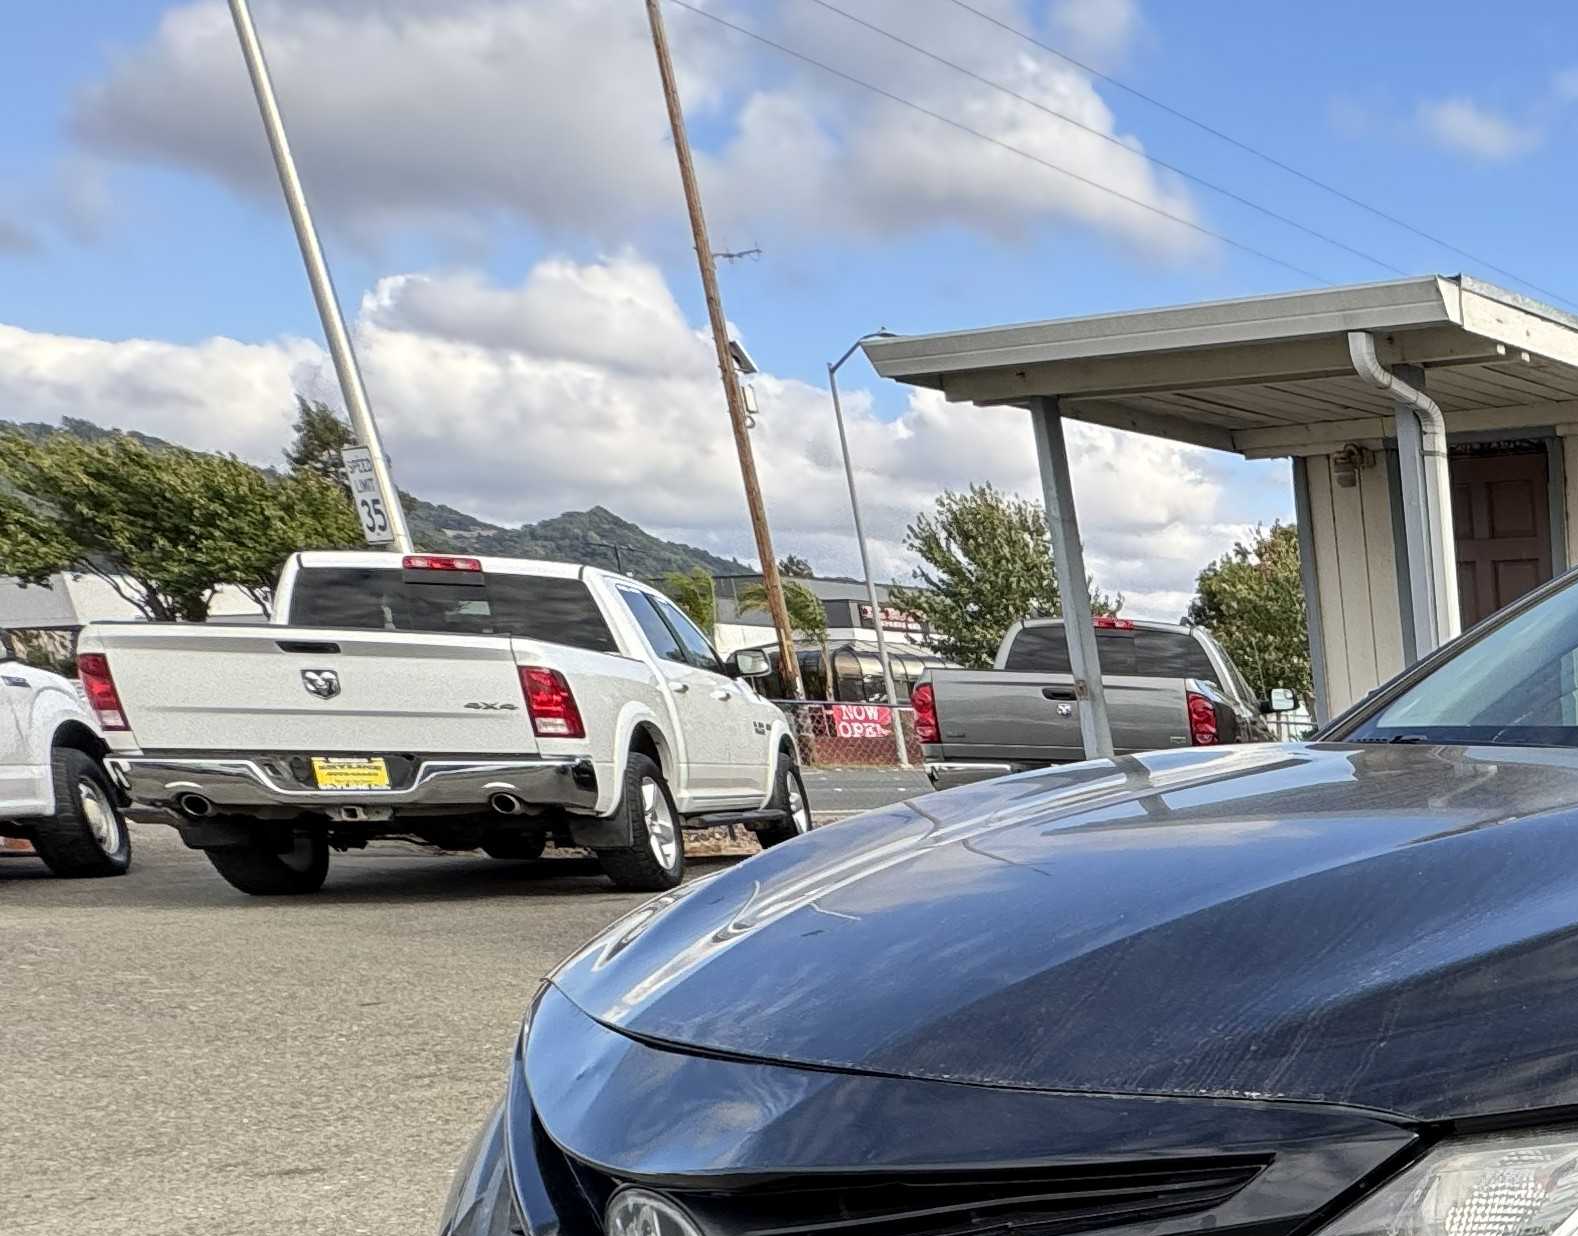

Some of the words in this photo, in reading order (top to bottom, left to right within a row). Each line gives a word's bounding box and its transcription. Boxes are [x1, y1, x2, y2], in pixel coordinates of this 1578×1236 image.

[346, 457, 372, 473] SPEED
[353, 478, 375, 493] LIMIT
[361, 498, 388, 533] 35
[840, 705, 879, 721] NOW
